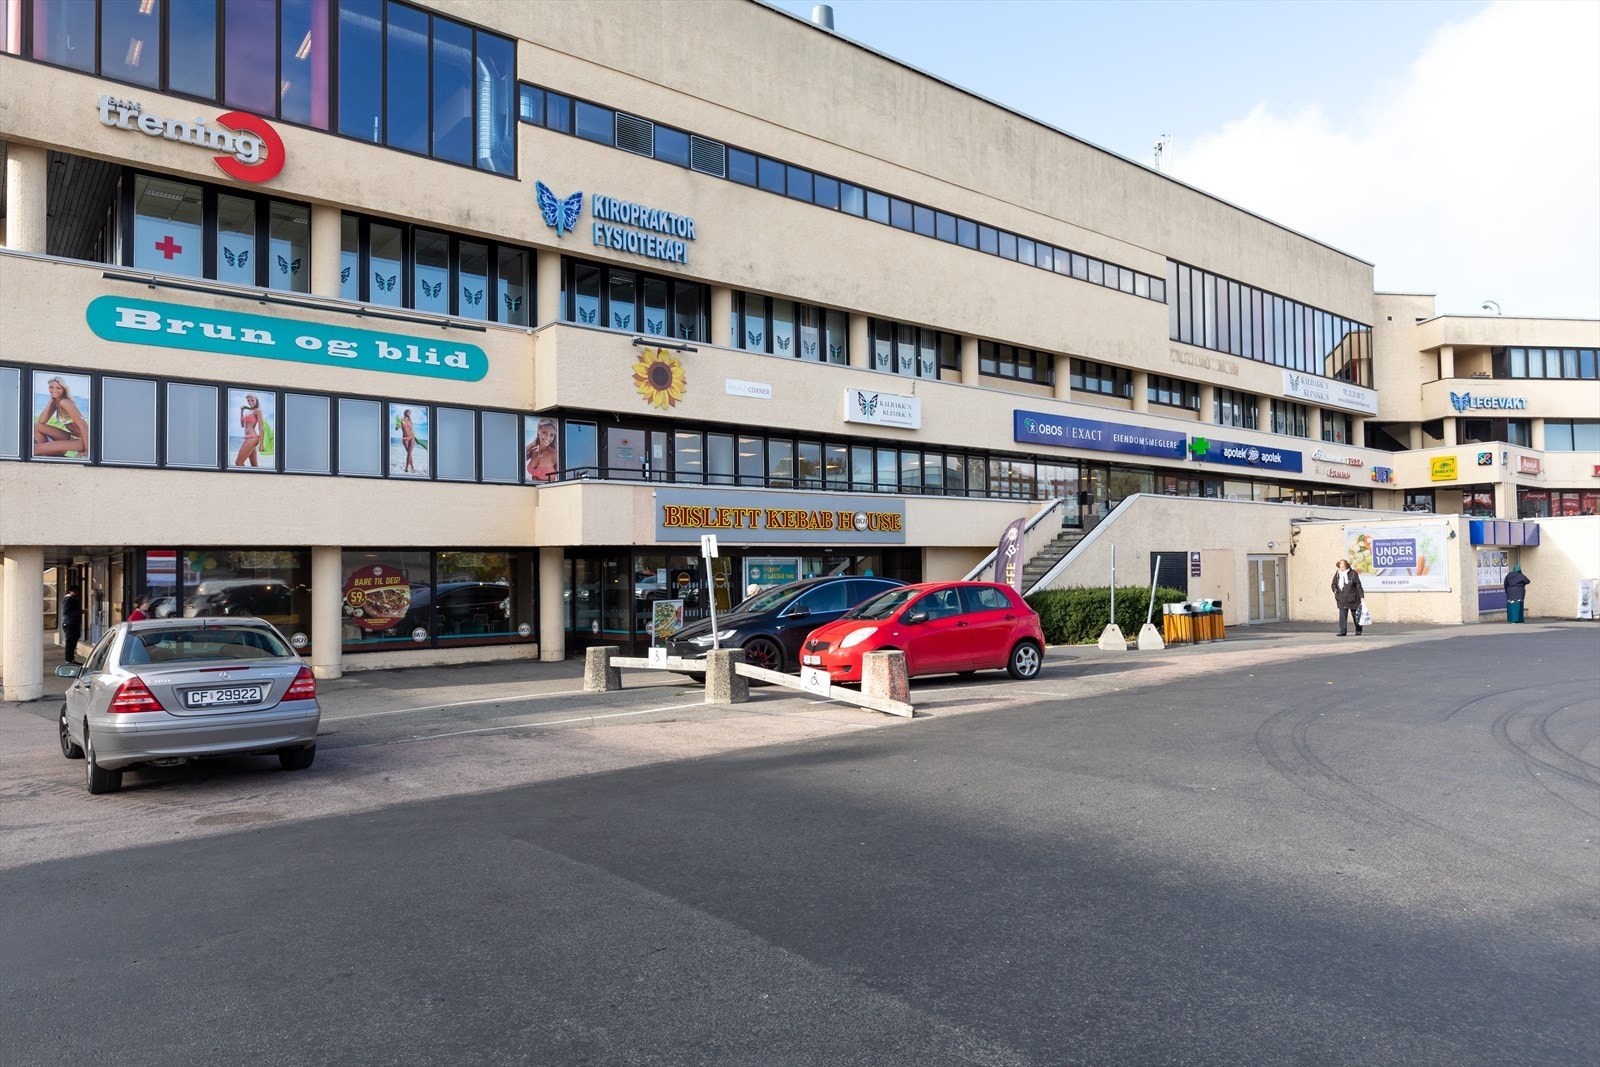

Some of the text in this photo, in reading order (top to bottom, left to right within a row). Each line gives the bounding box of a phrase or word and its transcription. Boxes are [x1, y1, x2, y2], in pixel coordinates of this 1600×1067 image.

[108, 96, 141, 111] BARE
[97, 95, 264, 164] trening
[592, 193, 696, 241] KIROPRAKTOR
[593, 221, 688, 264] FYSIOTERAPI
[115, 306, 470, 370] Brun og blid
[747, 386, 770, 396] CORNER
[1469, 396, 1528, 409] LEGEVAKT
[1038, 423, 1178, 449] OBOS EXACT EIENDOMSMEGLERE
[1223, 447, 1247, 459] apotek
[1261, 452, 1282, 464] apotek
[664, 505, 762, 530] BISLETT
[765, 508, 834, 532] KEBAB
[1375, 546, 1413, 556] UNDER
[1375, 556, 1394, 565] 100
[354, 576, 401, 586] BARE TIL DEG!
[191, 692, 208, 703] CF
[216, 689, 257, 700] 29922
